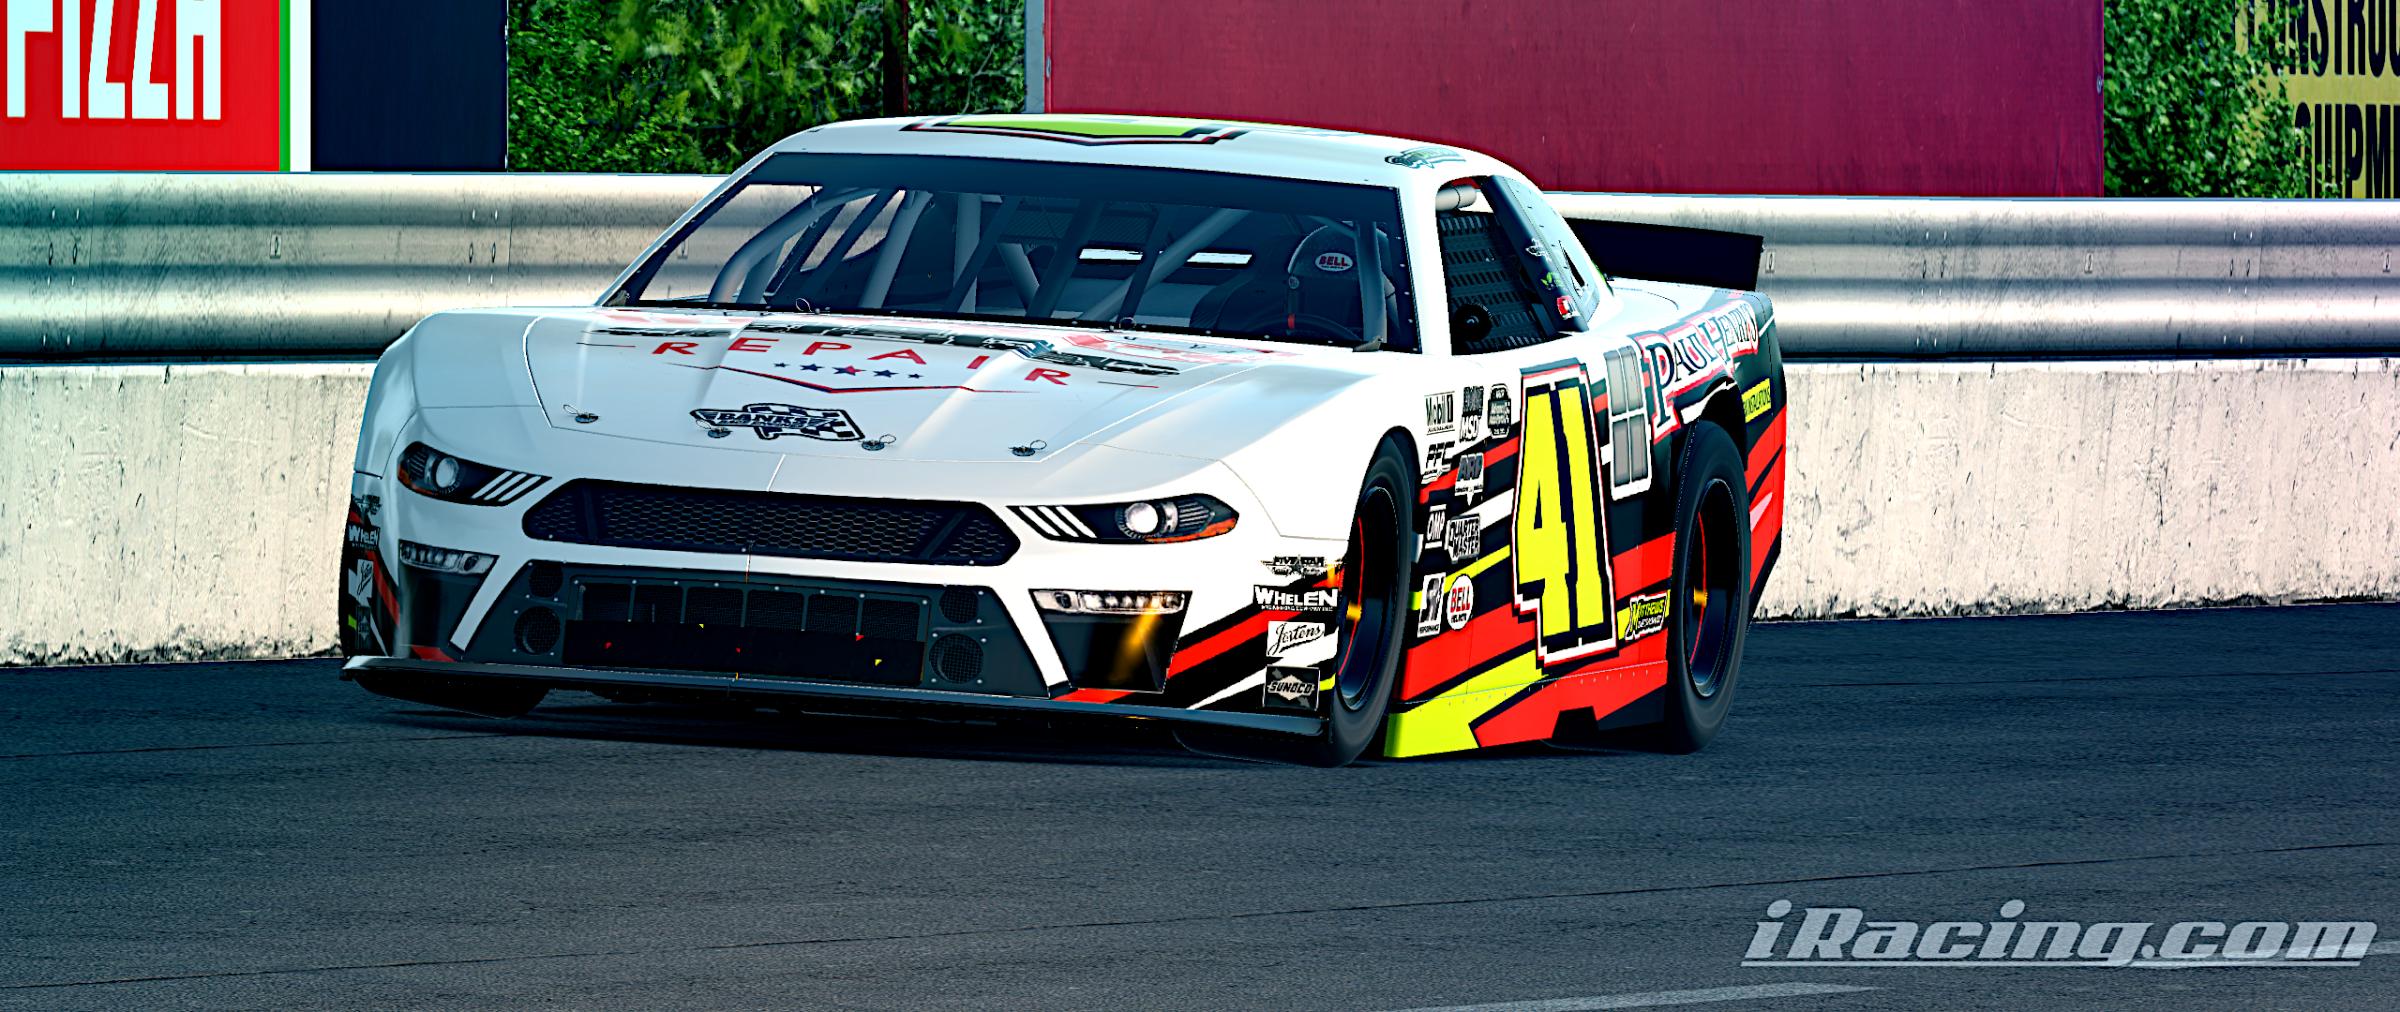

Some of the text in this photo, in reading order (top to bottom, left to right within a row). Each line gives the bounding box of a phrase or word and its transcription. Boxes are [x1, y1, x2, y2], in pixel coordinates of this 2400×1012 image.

[6, 0, 222, 120] PIZZA
[1318, 256, 1349, 267] BELL
[651, 336, 1071, 387] REPAIR
[1515, 383, 1606, 639] 41
[1254, 585, 1339, 608] WHELEN
[1450, 586, 1471, 614] BELL
[1268, 681, 1314, 694] SUNOCO
